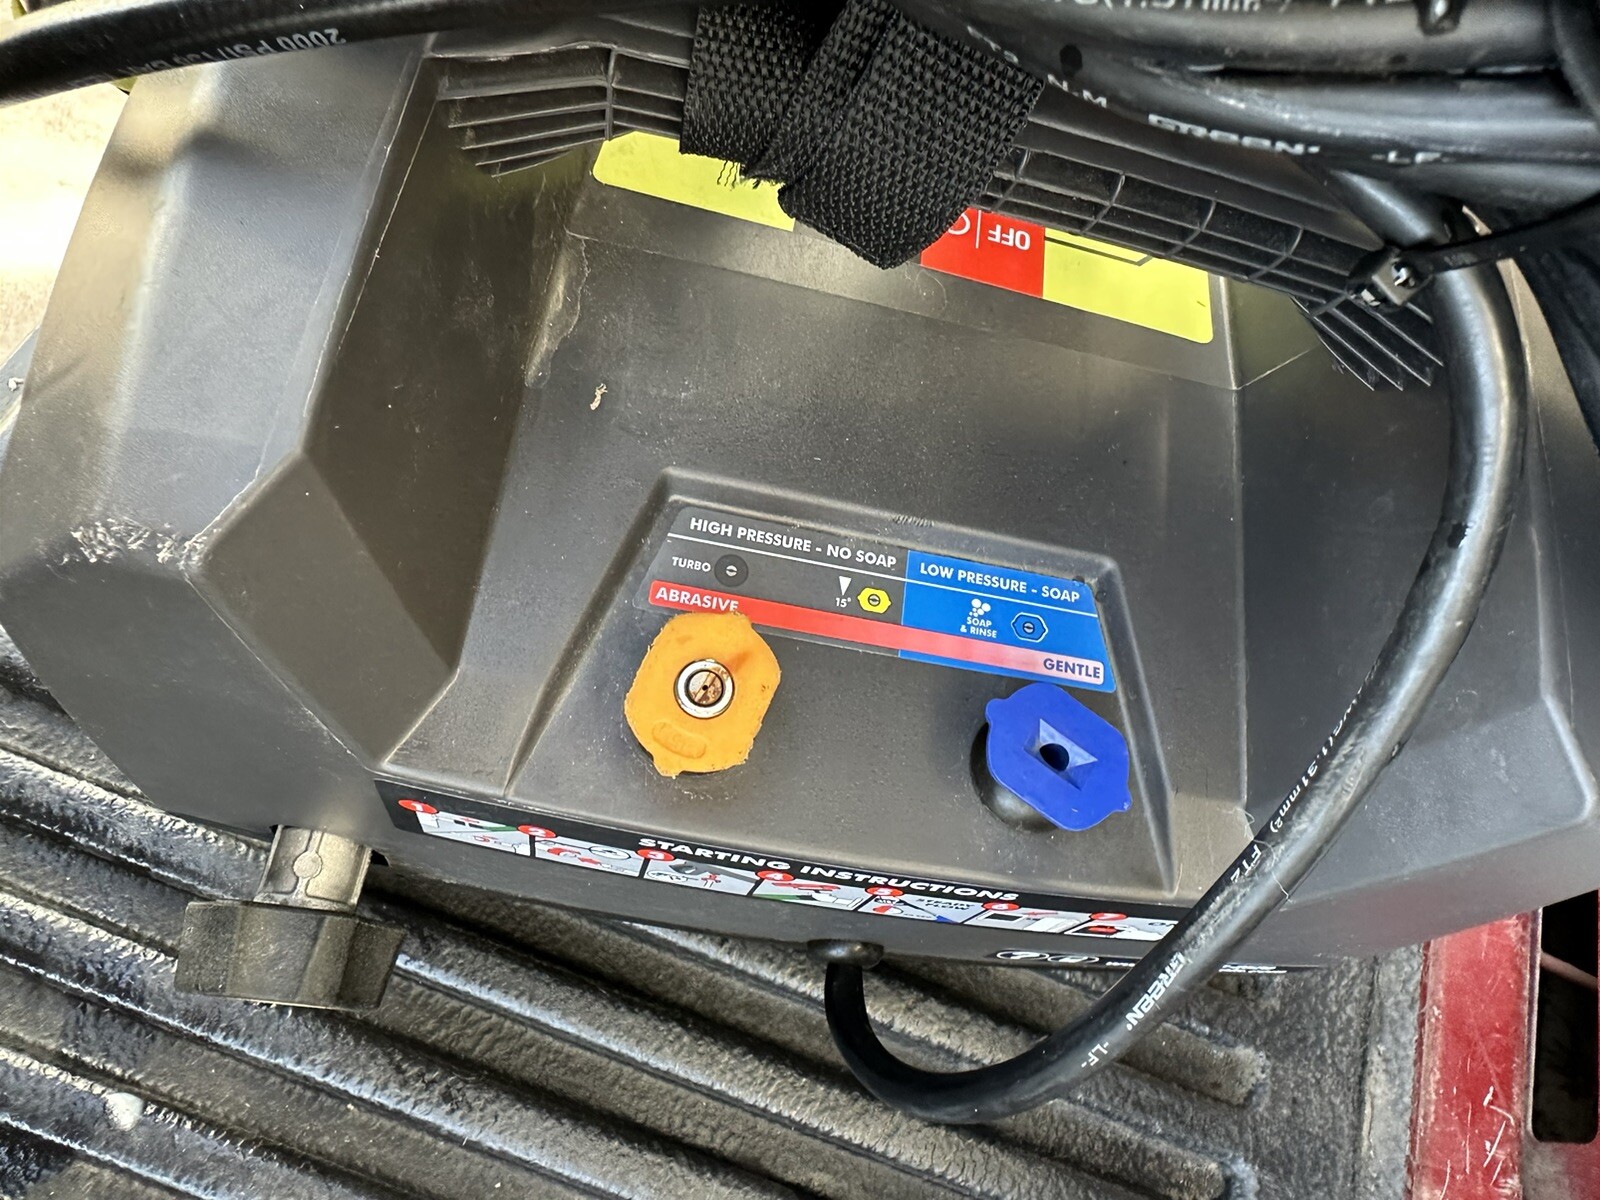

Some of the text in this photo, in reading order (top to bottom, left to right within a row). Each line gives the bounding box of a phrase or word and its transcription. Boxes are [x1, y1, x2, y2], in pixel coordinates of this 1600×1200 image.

[275, 27, 347, 51] 2000
[988, 223, 1031, 251] OFF
[689, 517, 733, 538] HIGH
[737, 528, 812, 552] PRESSURE
[826, 543, 852, 560] NO
[855, 550, 897, 569] SOAP
[671, 556, 712, 573] TURBO
[920, 562, 954, 579] LOW
[957, 569, 1027, 594] PRESSURE
[1041, 585, 1081, 603] SOAP
[655, 586, 740, 612] ABRASIVE
[835, 596, 852, 609] 15°
[960, 624, 998, 639] & RINSE
[966, 616, 993, 627] SOAP
[1043, 658, 1101, 680] GENTLE
[638, 838, 1020, 901] STARTING INSTRUCTIONS
